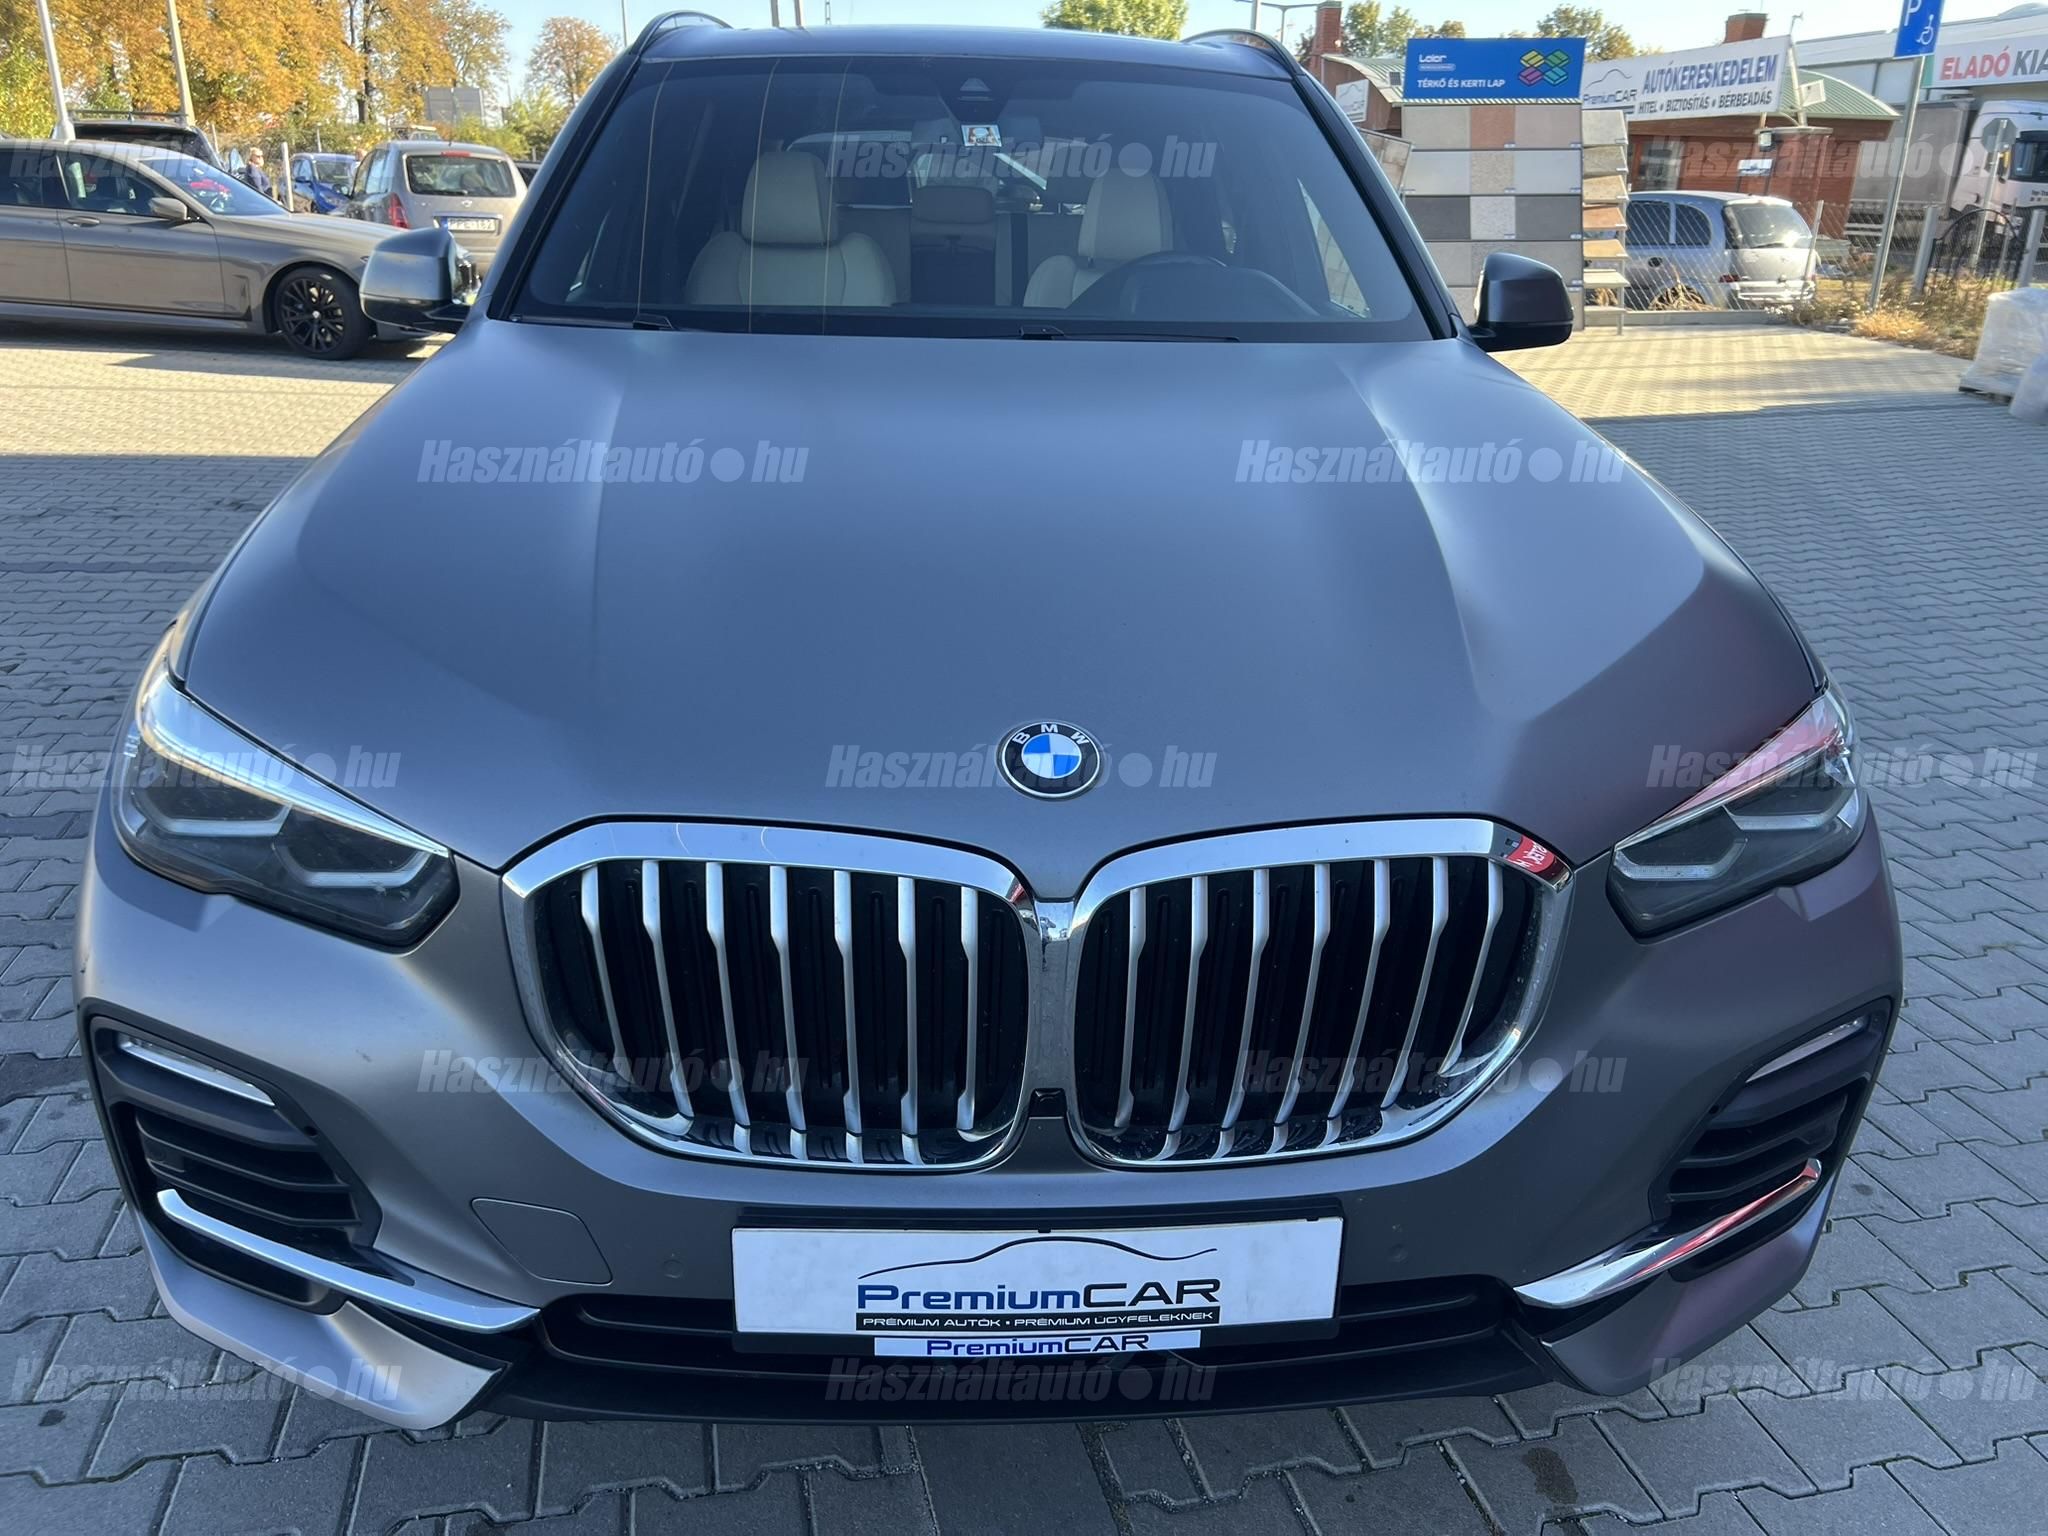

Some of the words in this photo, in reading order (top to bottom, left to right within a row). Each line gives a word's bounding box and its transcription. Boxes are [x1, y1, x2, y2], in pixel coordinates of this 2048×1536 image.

[1904, 0, 1922, 26] P
[1642, 54, 1779, 94] AUTÓKERESKEDELEM
[1940, 45, 2010, 80] ELADÓ
[1447, 77, 1460, 88] ÉS
[1461, 79, 1486, 88] KERTI
[1487, 79, 1506, 88] LAP
[1638, 100, 1658, 114] HITEL
[1666, 92, 1710, 112] BIZTOSÍTÁS
[1719, 86, 1773, 108] BÉRBEADÁS
[1012, 724, 1089, 745] BMW
[857, 1278, 1220, 1310] PremiumCAR
[926, 1334, 1149, 1356] PremiumCAR
